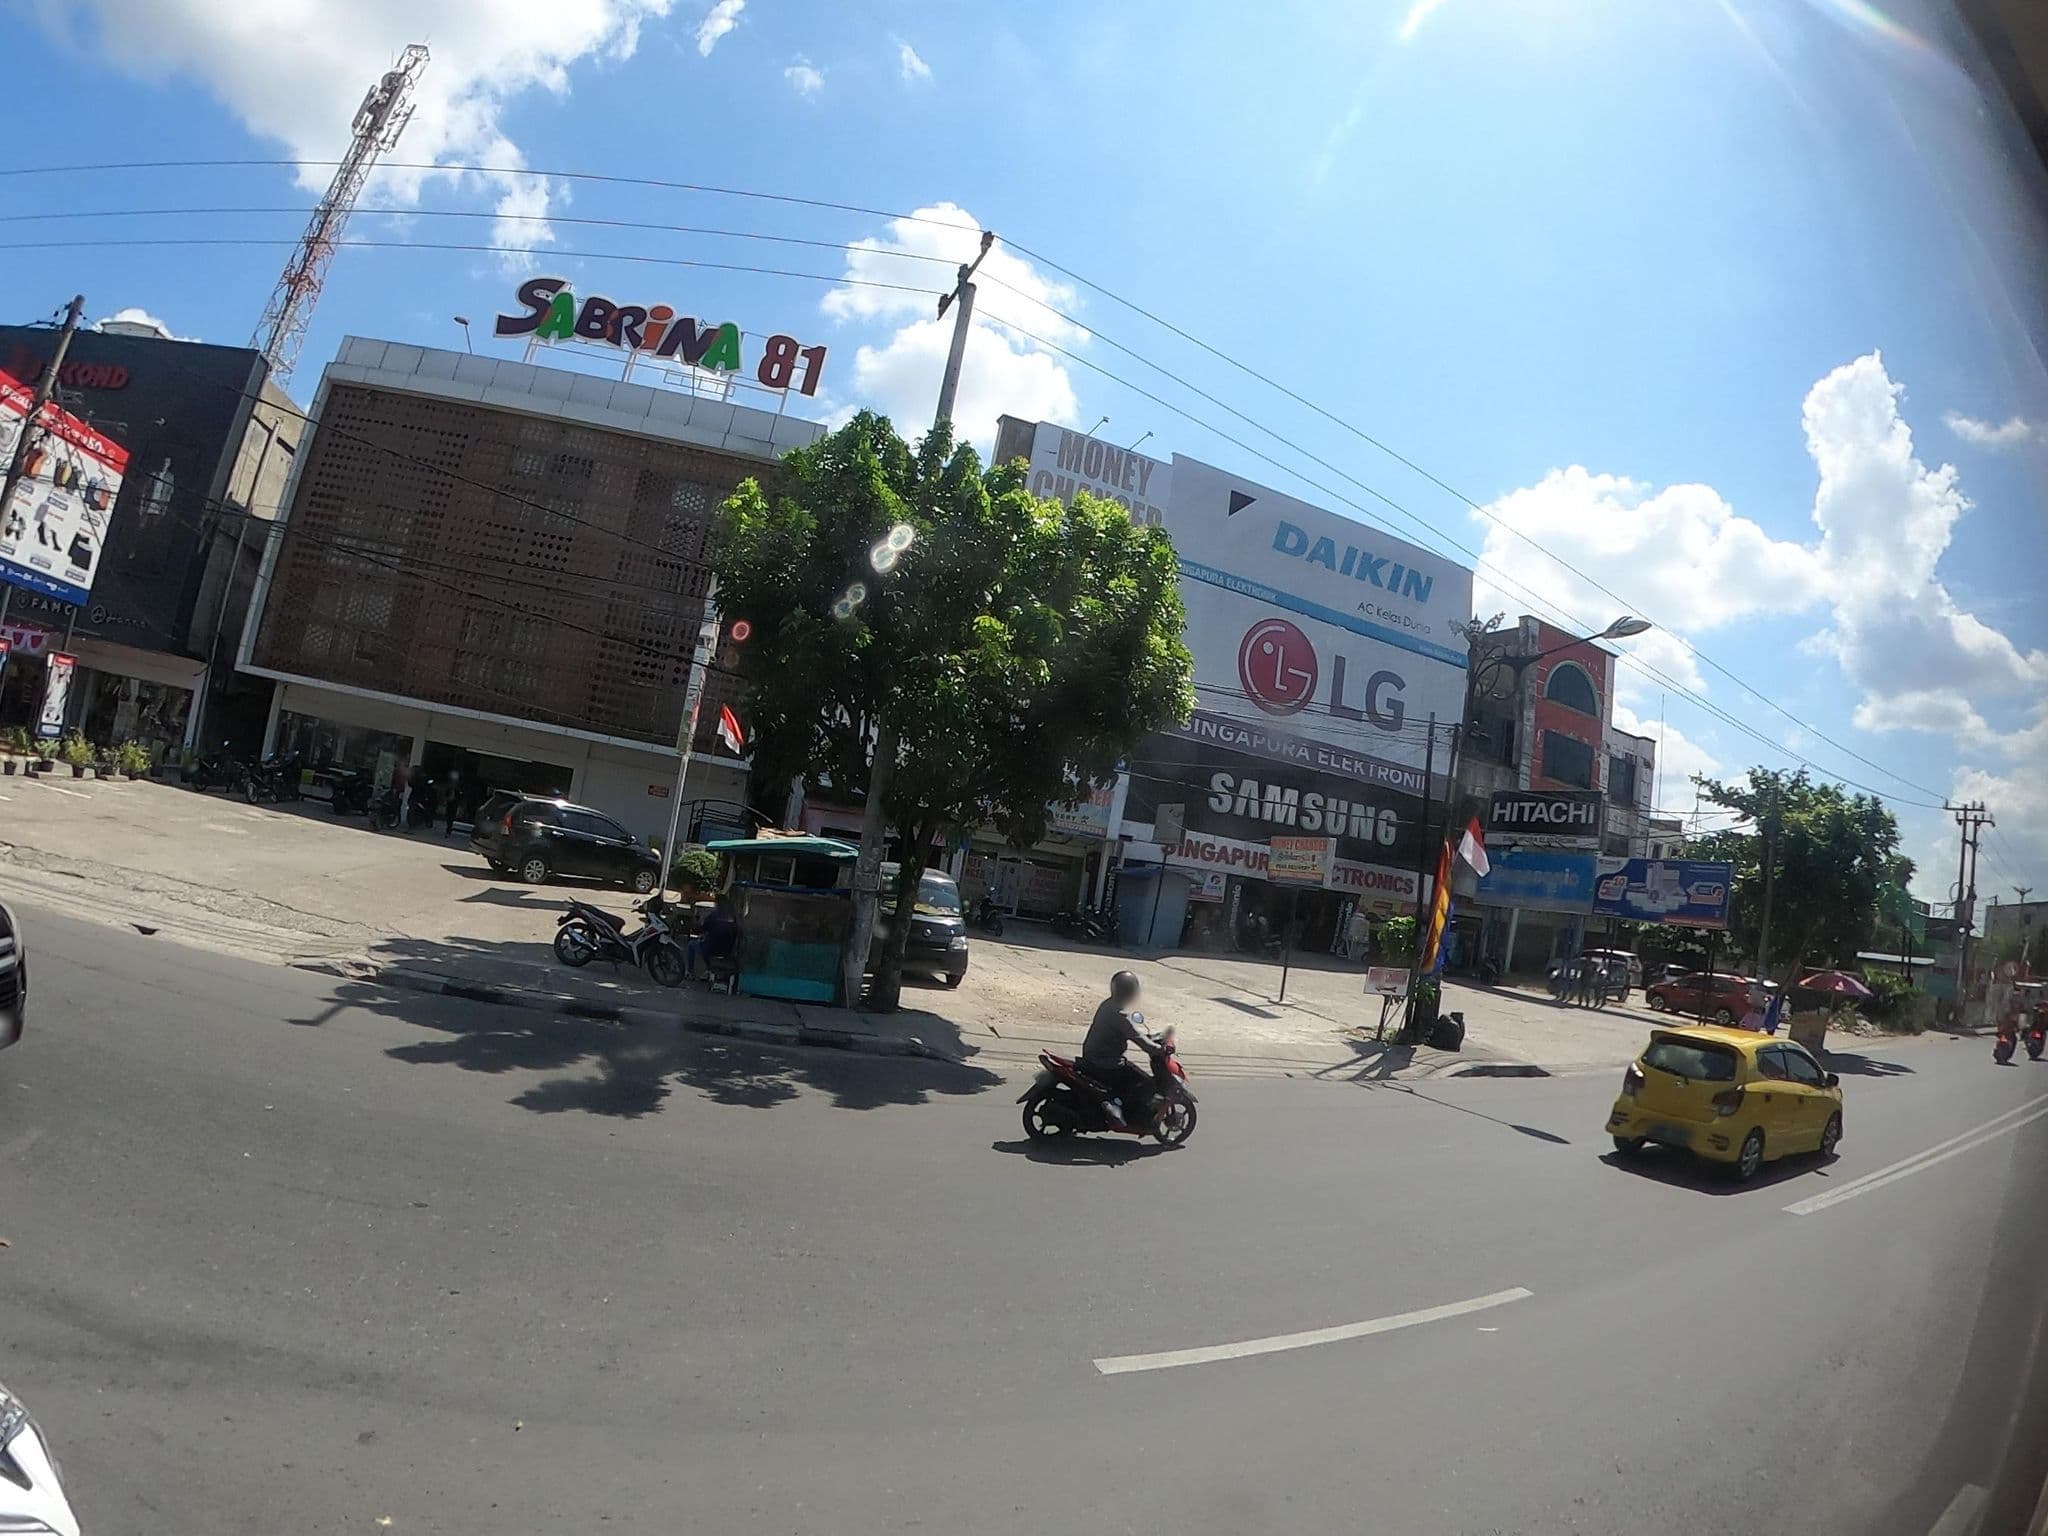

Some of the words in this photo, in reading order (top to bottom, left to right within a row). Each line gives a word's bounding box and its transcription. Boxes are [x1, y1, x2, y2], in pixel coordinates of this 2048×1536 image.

[757, 334, 827, 397] 81
[1056, 430, 1155, 496] MONEY
[1032, 470, 1162, 527] CHER
[1272, 520, 1433, 602] DAIKIN
[1357, 601, 1375, 615] AC
[1330, 654, 1407, 732] LG
[1207, 772, 1398, 846] SAMSUNG
[1492, 801, 1595, 824] HITACHI
